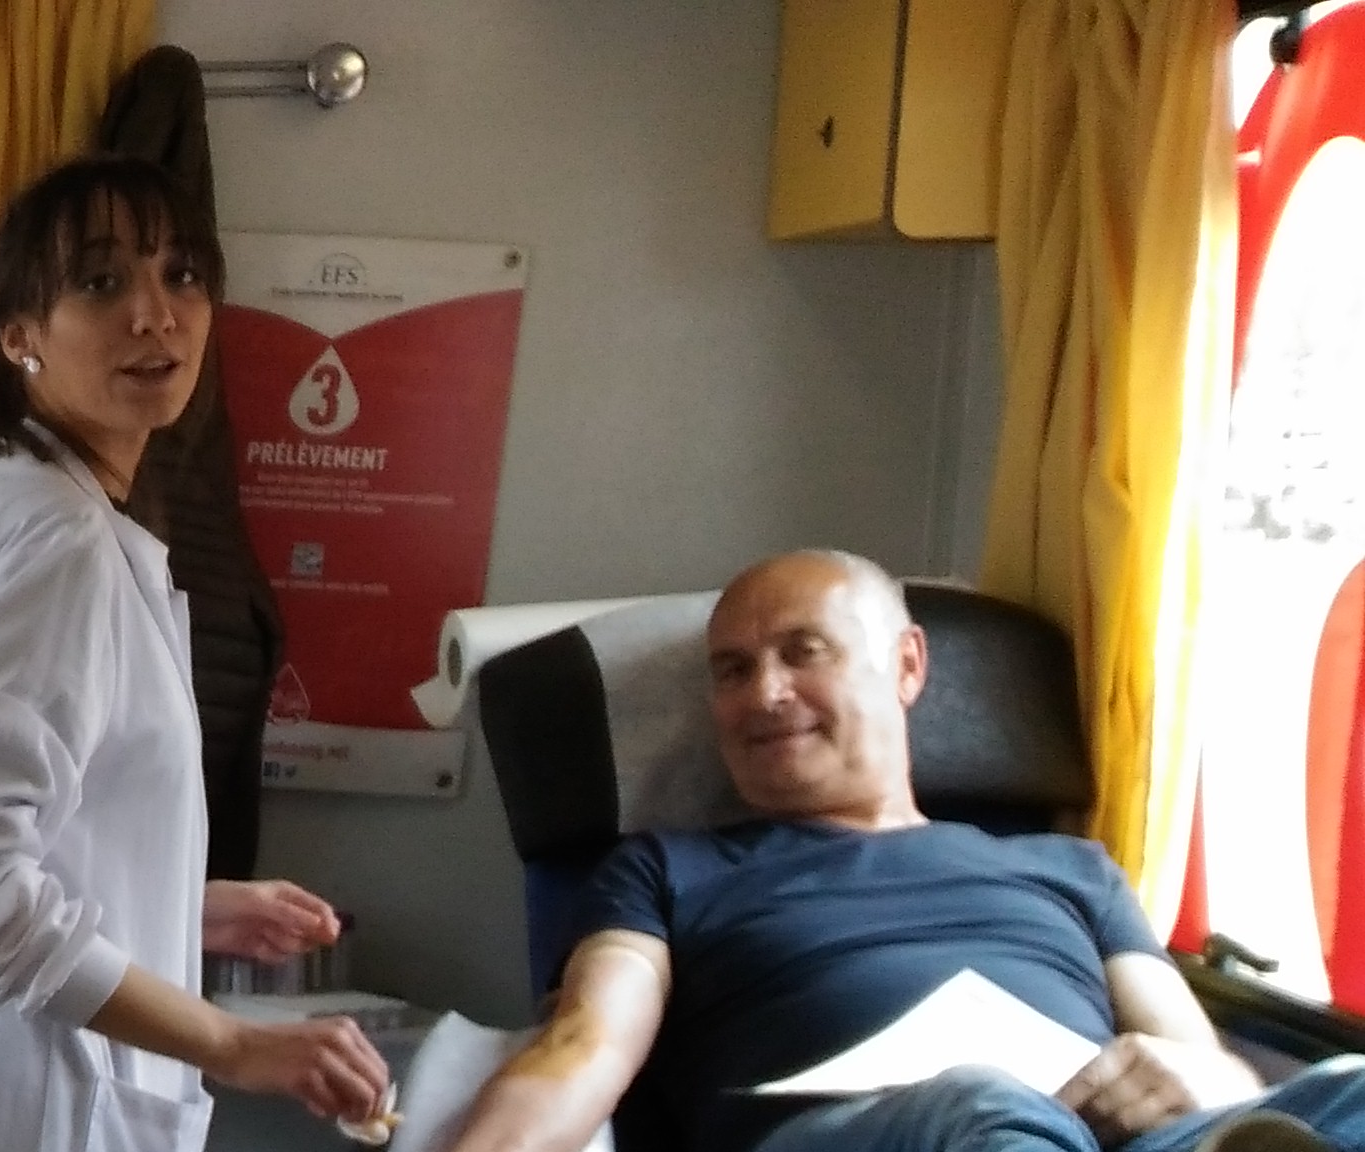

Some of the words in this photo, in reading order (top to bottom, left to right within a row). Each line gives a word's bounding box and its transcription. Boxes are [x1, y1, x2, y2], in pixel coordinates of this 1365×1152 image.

[321, 264, 359, 285] EFS
[306, 363, 341, 427] 3
[247, 440, 389, 472] PRÉLÈVEMENT
